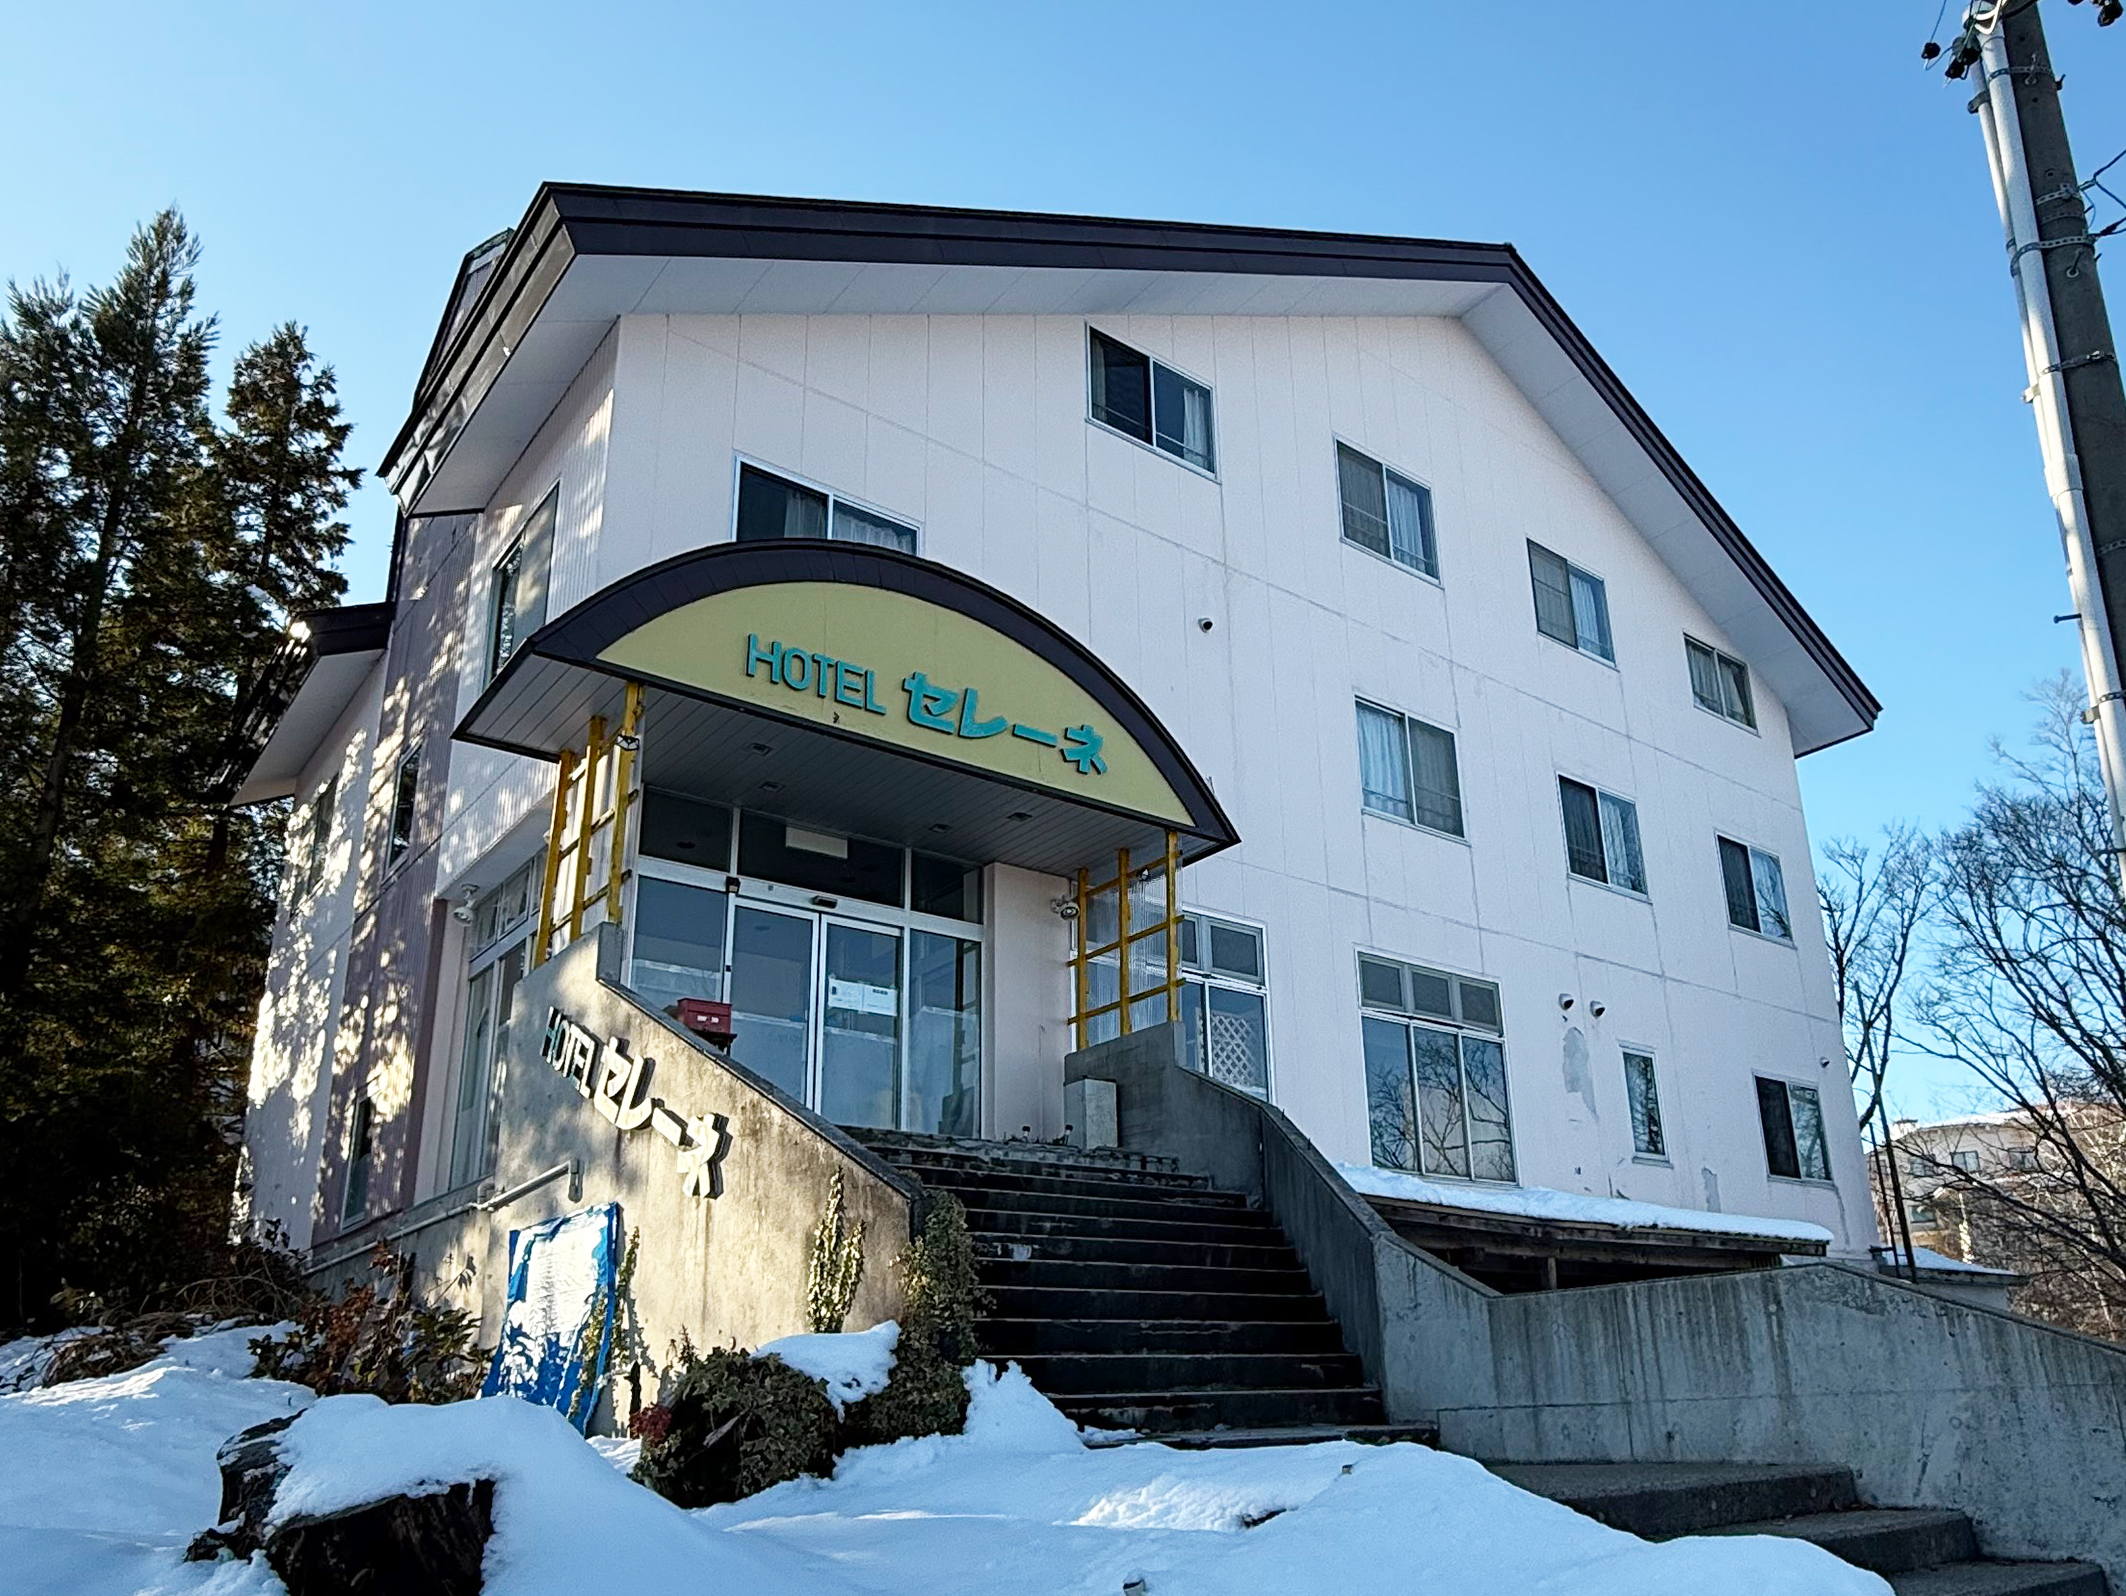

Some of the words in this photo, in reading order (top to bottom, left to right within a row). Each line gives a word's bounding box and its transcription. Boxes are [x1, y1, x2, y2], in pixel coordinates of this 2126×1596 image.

[746, 633, 886, 715] HOTEL
[902, 671, 1108, 775] セレーネ
[540, 1005, 598, 1100] HOTEL
[593, 1035, 722, 1199] セレーネ
